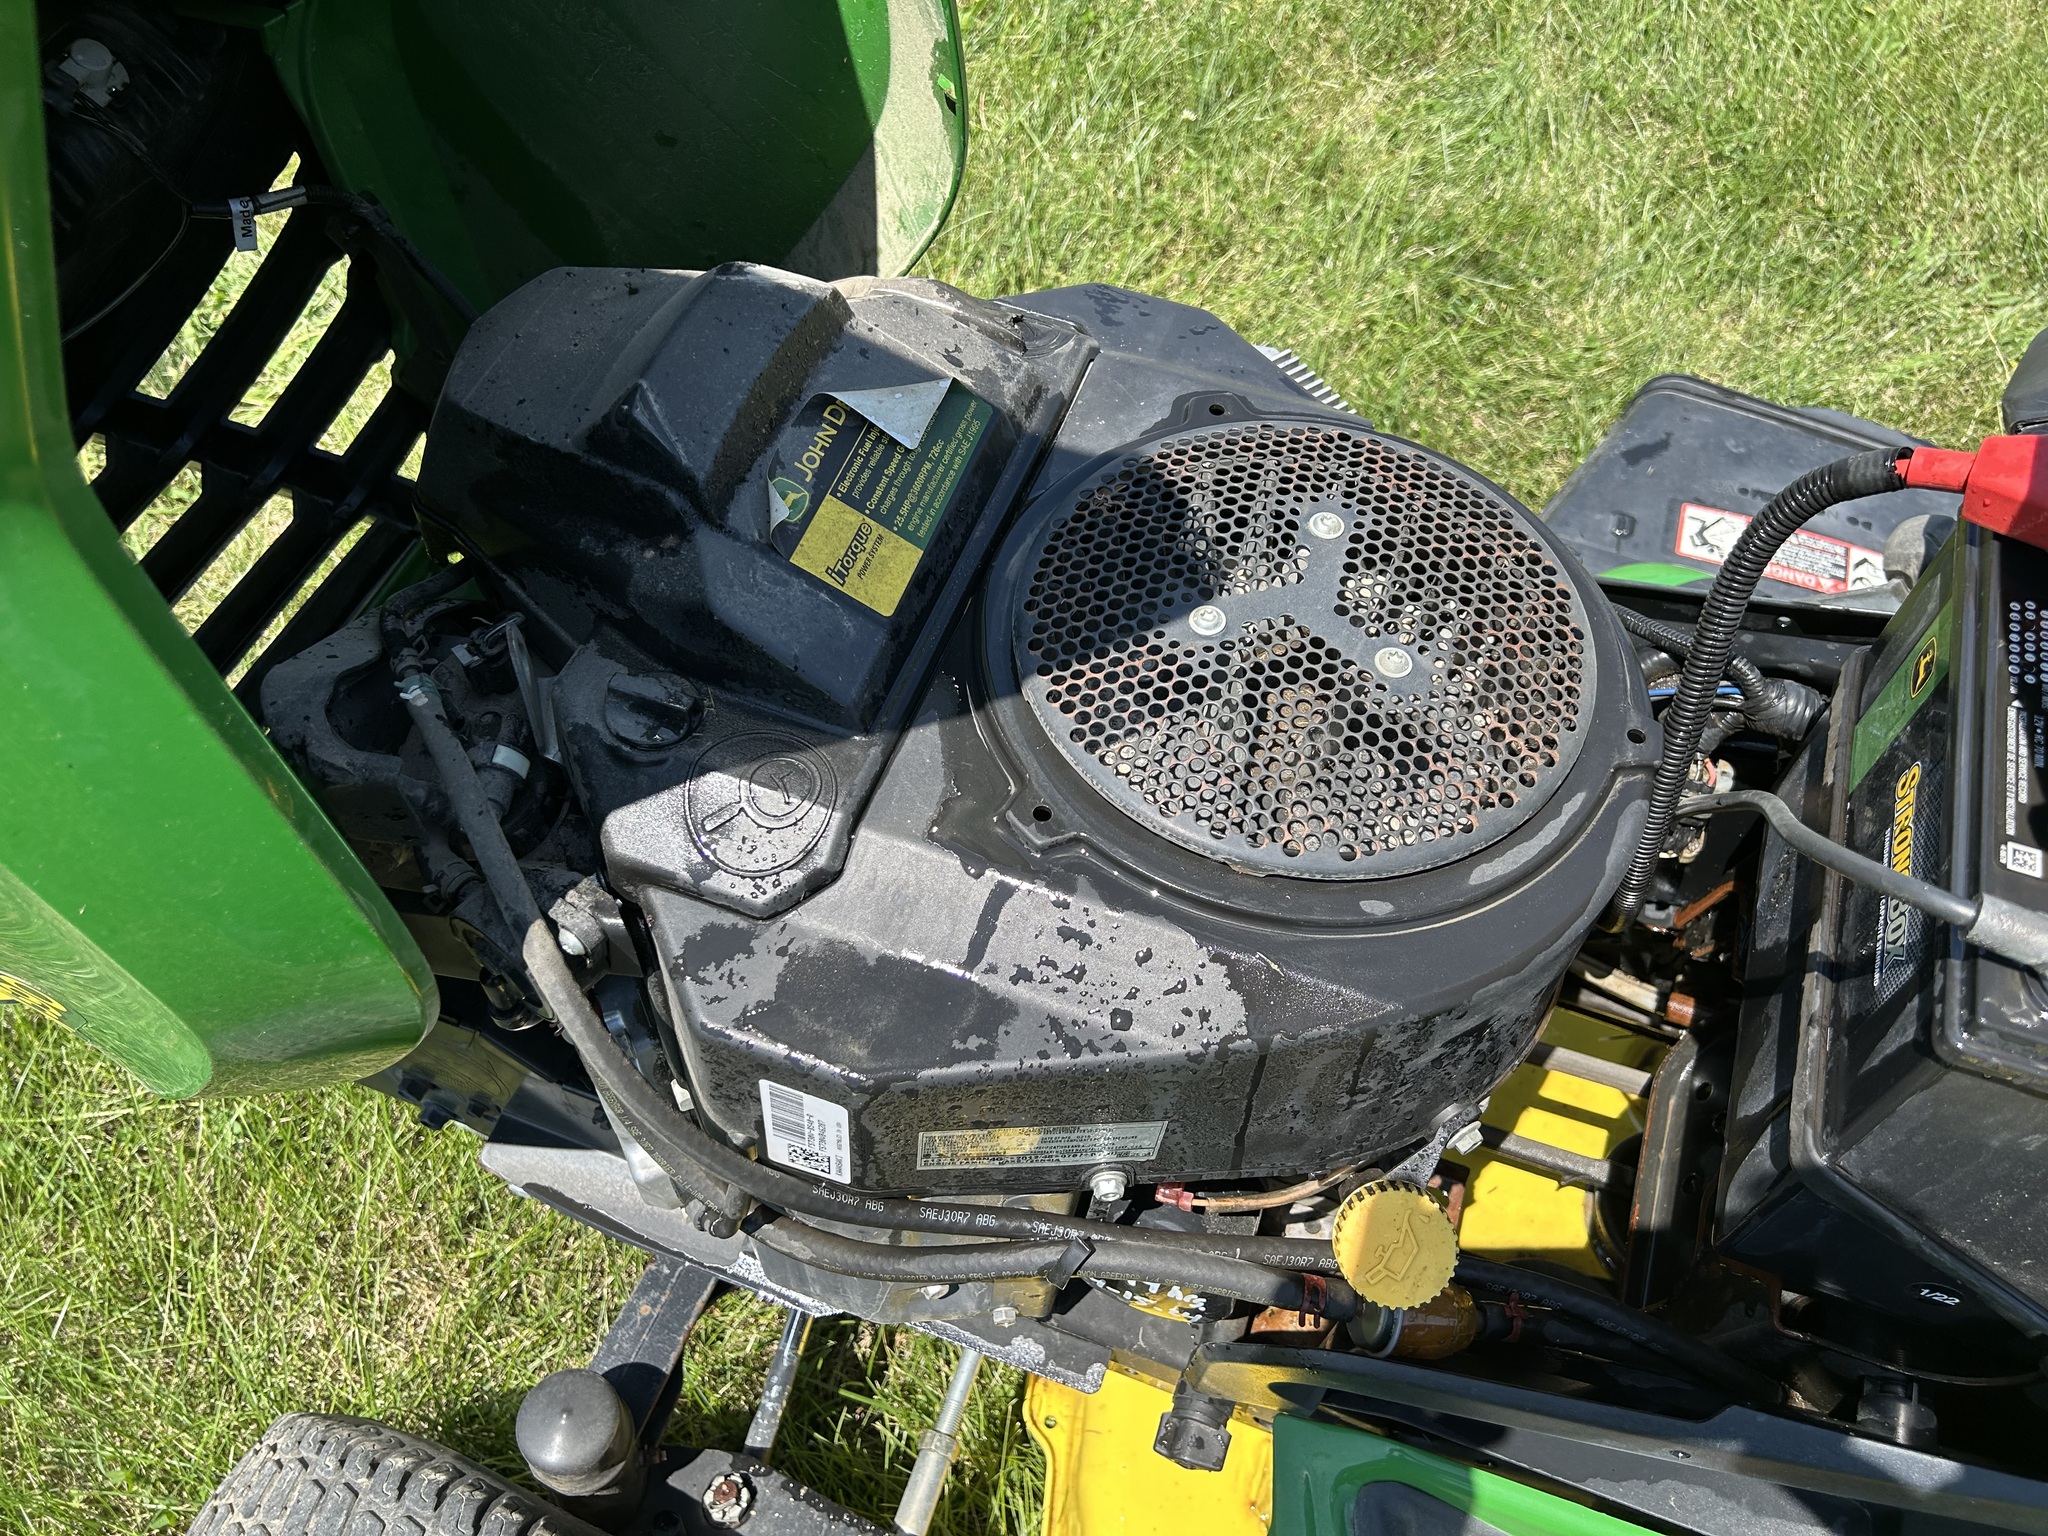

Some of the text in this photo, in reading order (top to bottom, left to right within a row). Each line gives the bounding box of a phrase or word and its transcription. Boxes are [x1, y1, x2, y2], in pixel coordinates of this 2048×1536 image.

[240, 198, 253, 238] Made
[794, 421, 838, 483] JOHN
[838, 456, 864, 494] Electronic
[858, 438, 873, 457] Fuel
[907, 400, 978, 532] engine manufacturer certified gross power
[928, 439, 944, 460] 726cc
[852, 468, 872, 499] provides
[868, 443, 886, 469] reliable
[866, 476, 890, 510] Constant
[884, 452, 902, 476] Speed
[880, 486, 898, 515] charges
[893, 460, 913, 488] through
[917, 418, 981, 538] tested in accordance with SAE J1995
[825, 522, 873, 587] iTorque
[857, 533, 885, 580] POWER SYSTEM
[2034, 715, 2044, 728] 12V
[2034, 734, 2044, 744] RC
[2018, 758, 2028, 780] SERVICE
[2018, 780, 2028, 804] RECORD
[812, 1184, 884, 1212] SAEJ30R7 ABG
[919, 1206, 996, 1226] SAEJ30R7 ABG
[1263, 1254, 1338, 1269] SAEJ30R7 ABG
[1920, 1288, 1960, 1306] 1/22
